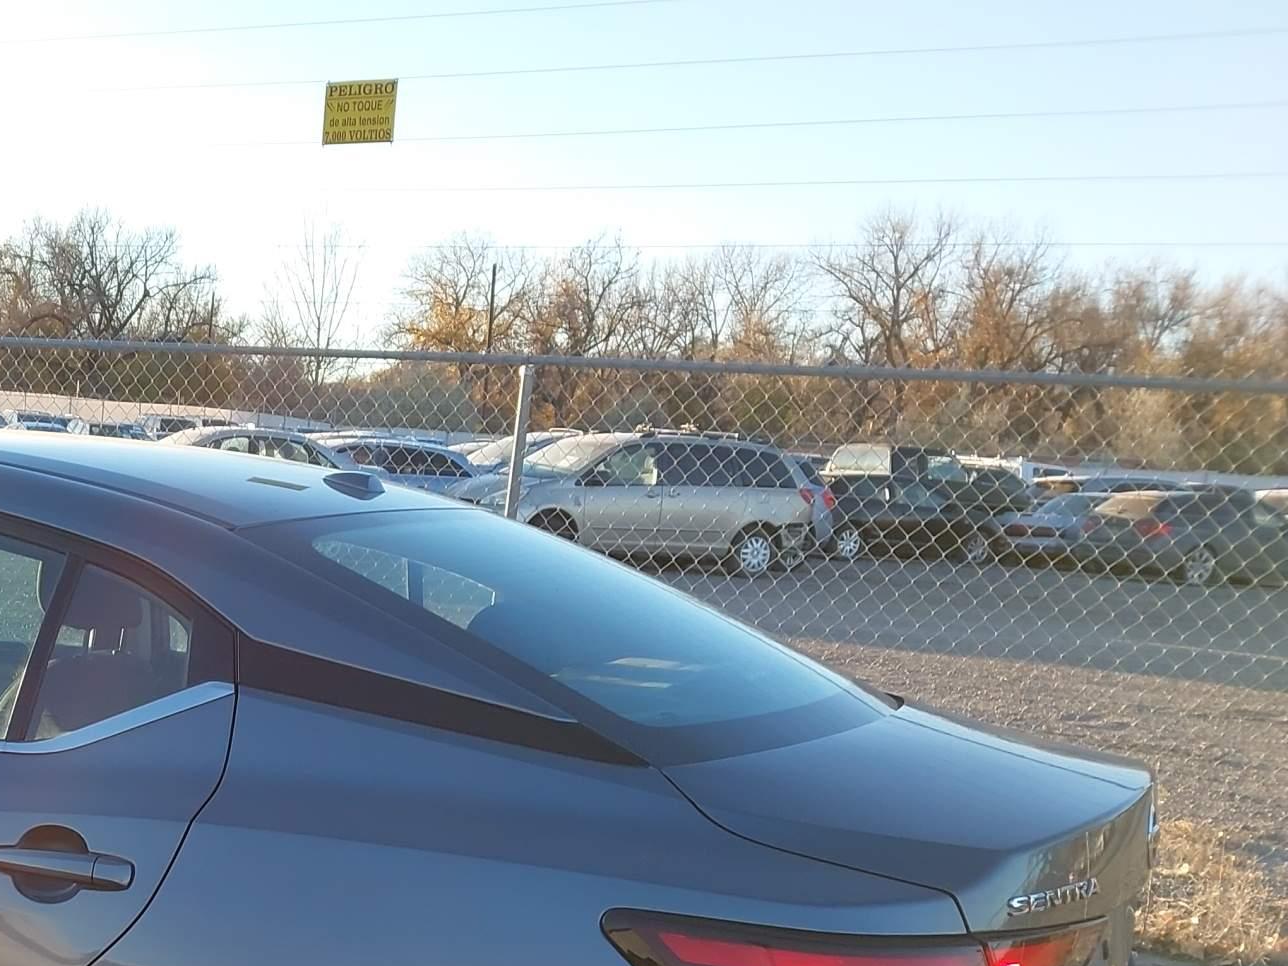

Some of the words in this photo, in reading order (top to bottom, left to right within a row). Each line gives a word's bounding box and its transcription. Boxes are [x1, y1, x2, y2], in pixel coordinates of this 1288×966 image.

[329, 82, 395, 97] PELIGRO
[336, 102, 350, 112] NO
[352, 99, 383, 112] TOQUE
[329, 117, 340, 127] de
[341, 116, 357, 127] alta
[348, 128, 392, 141] VOLTIOS
[1007, 877, 1099, 917] SENTRA
